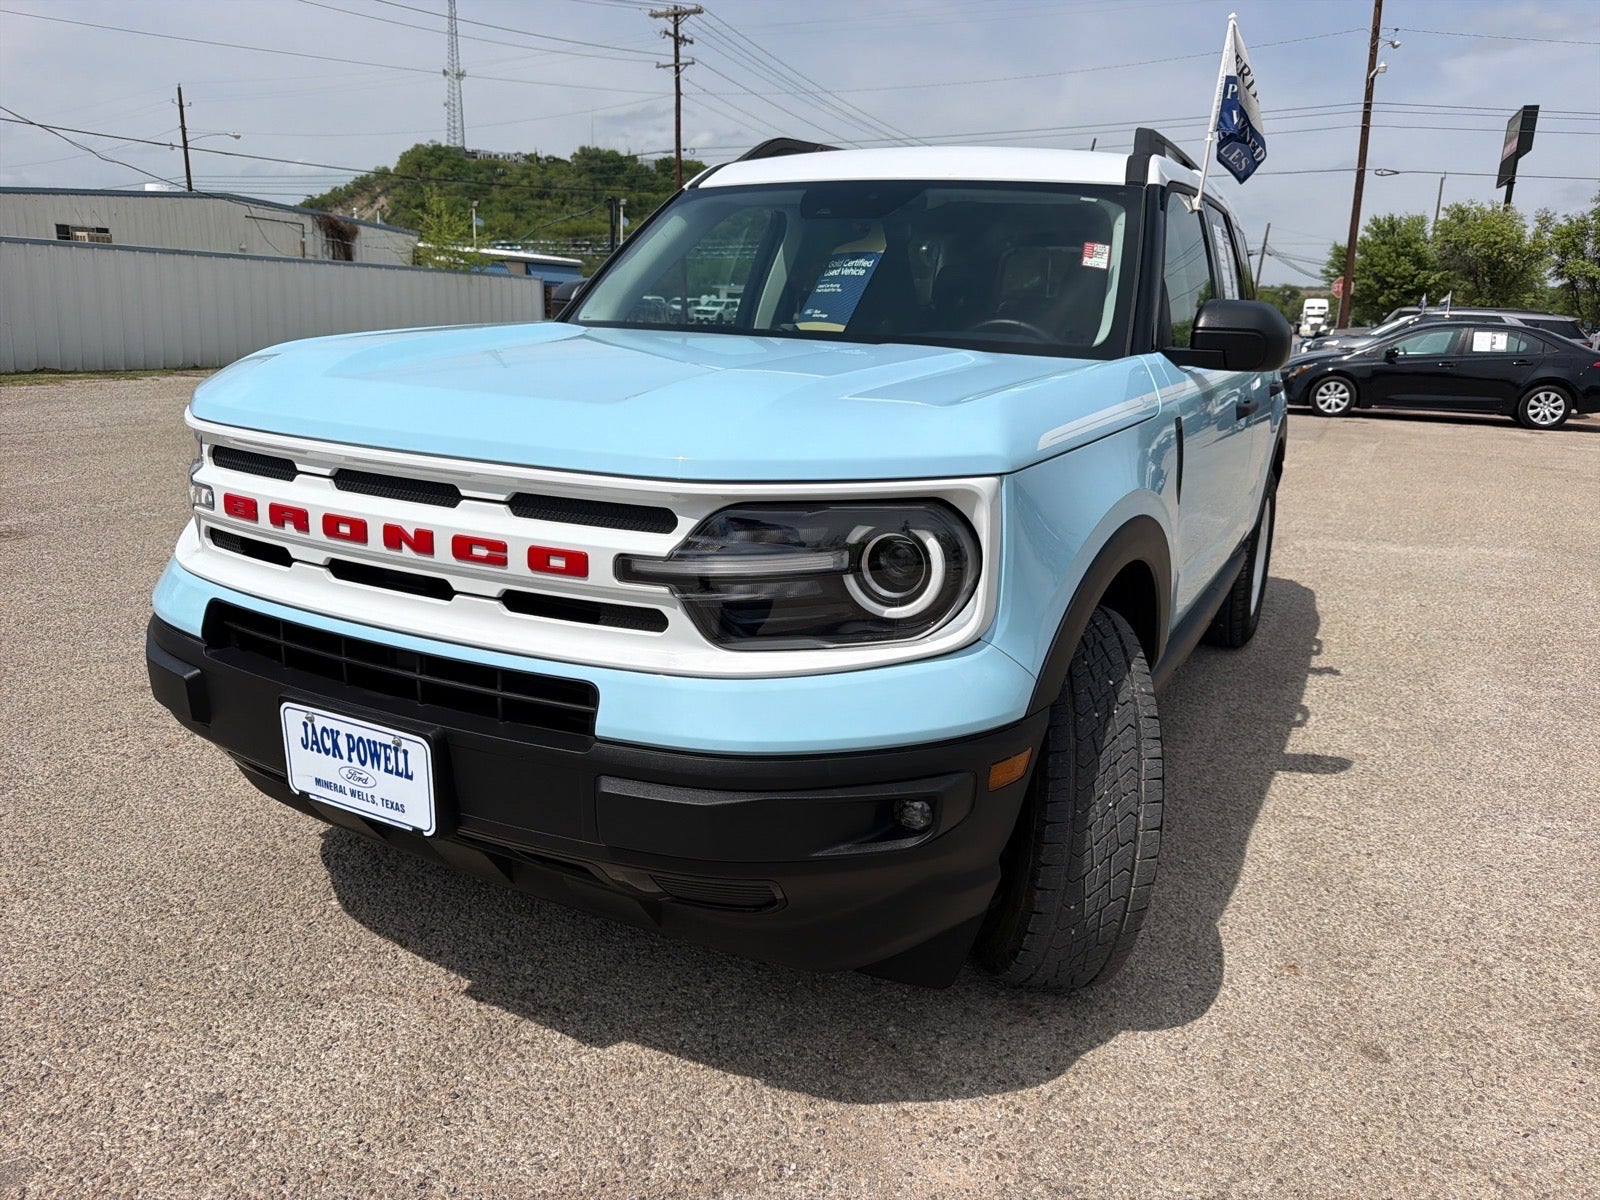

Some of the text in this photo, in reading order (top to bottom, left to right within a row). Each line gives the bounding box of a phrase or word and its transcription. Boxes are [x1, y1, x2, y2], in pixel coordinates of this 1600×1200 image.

[823, 267, 866, 277] Used Vehicle
[843, 258, 874, 268] Certified
[223, 491, 589, 578] BRONCO
[301, 721, 414, 781] JACK POWELL
[344, 768, 370, 786] Ford
[314, 777, 406, 814] MINERAL WELLS, TEXAS
